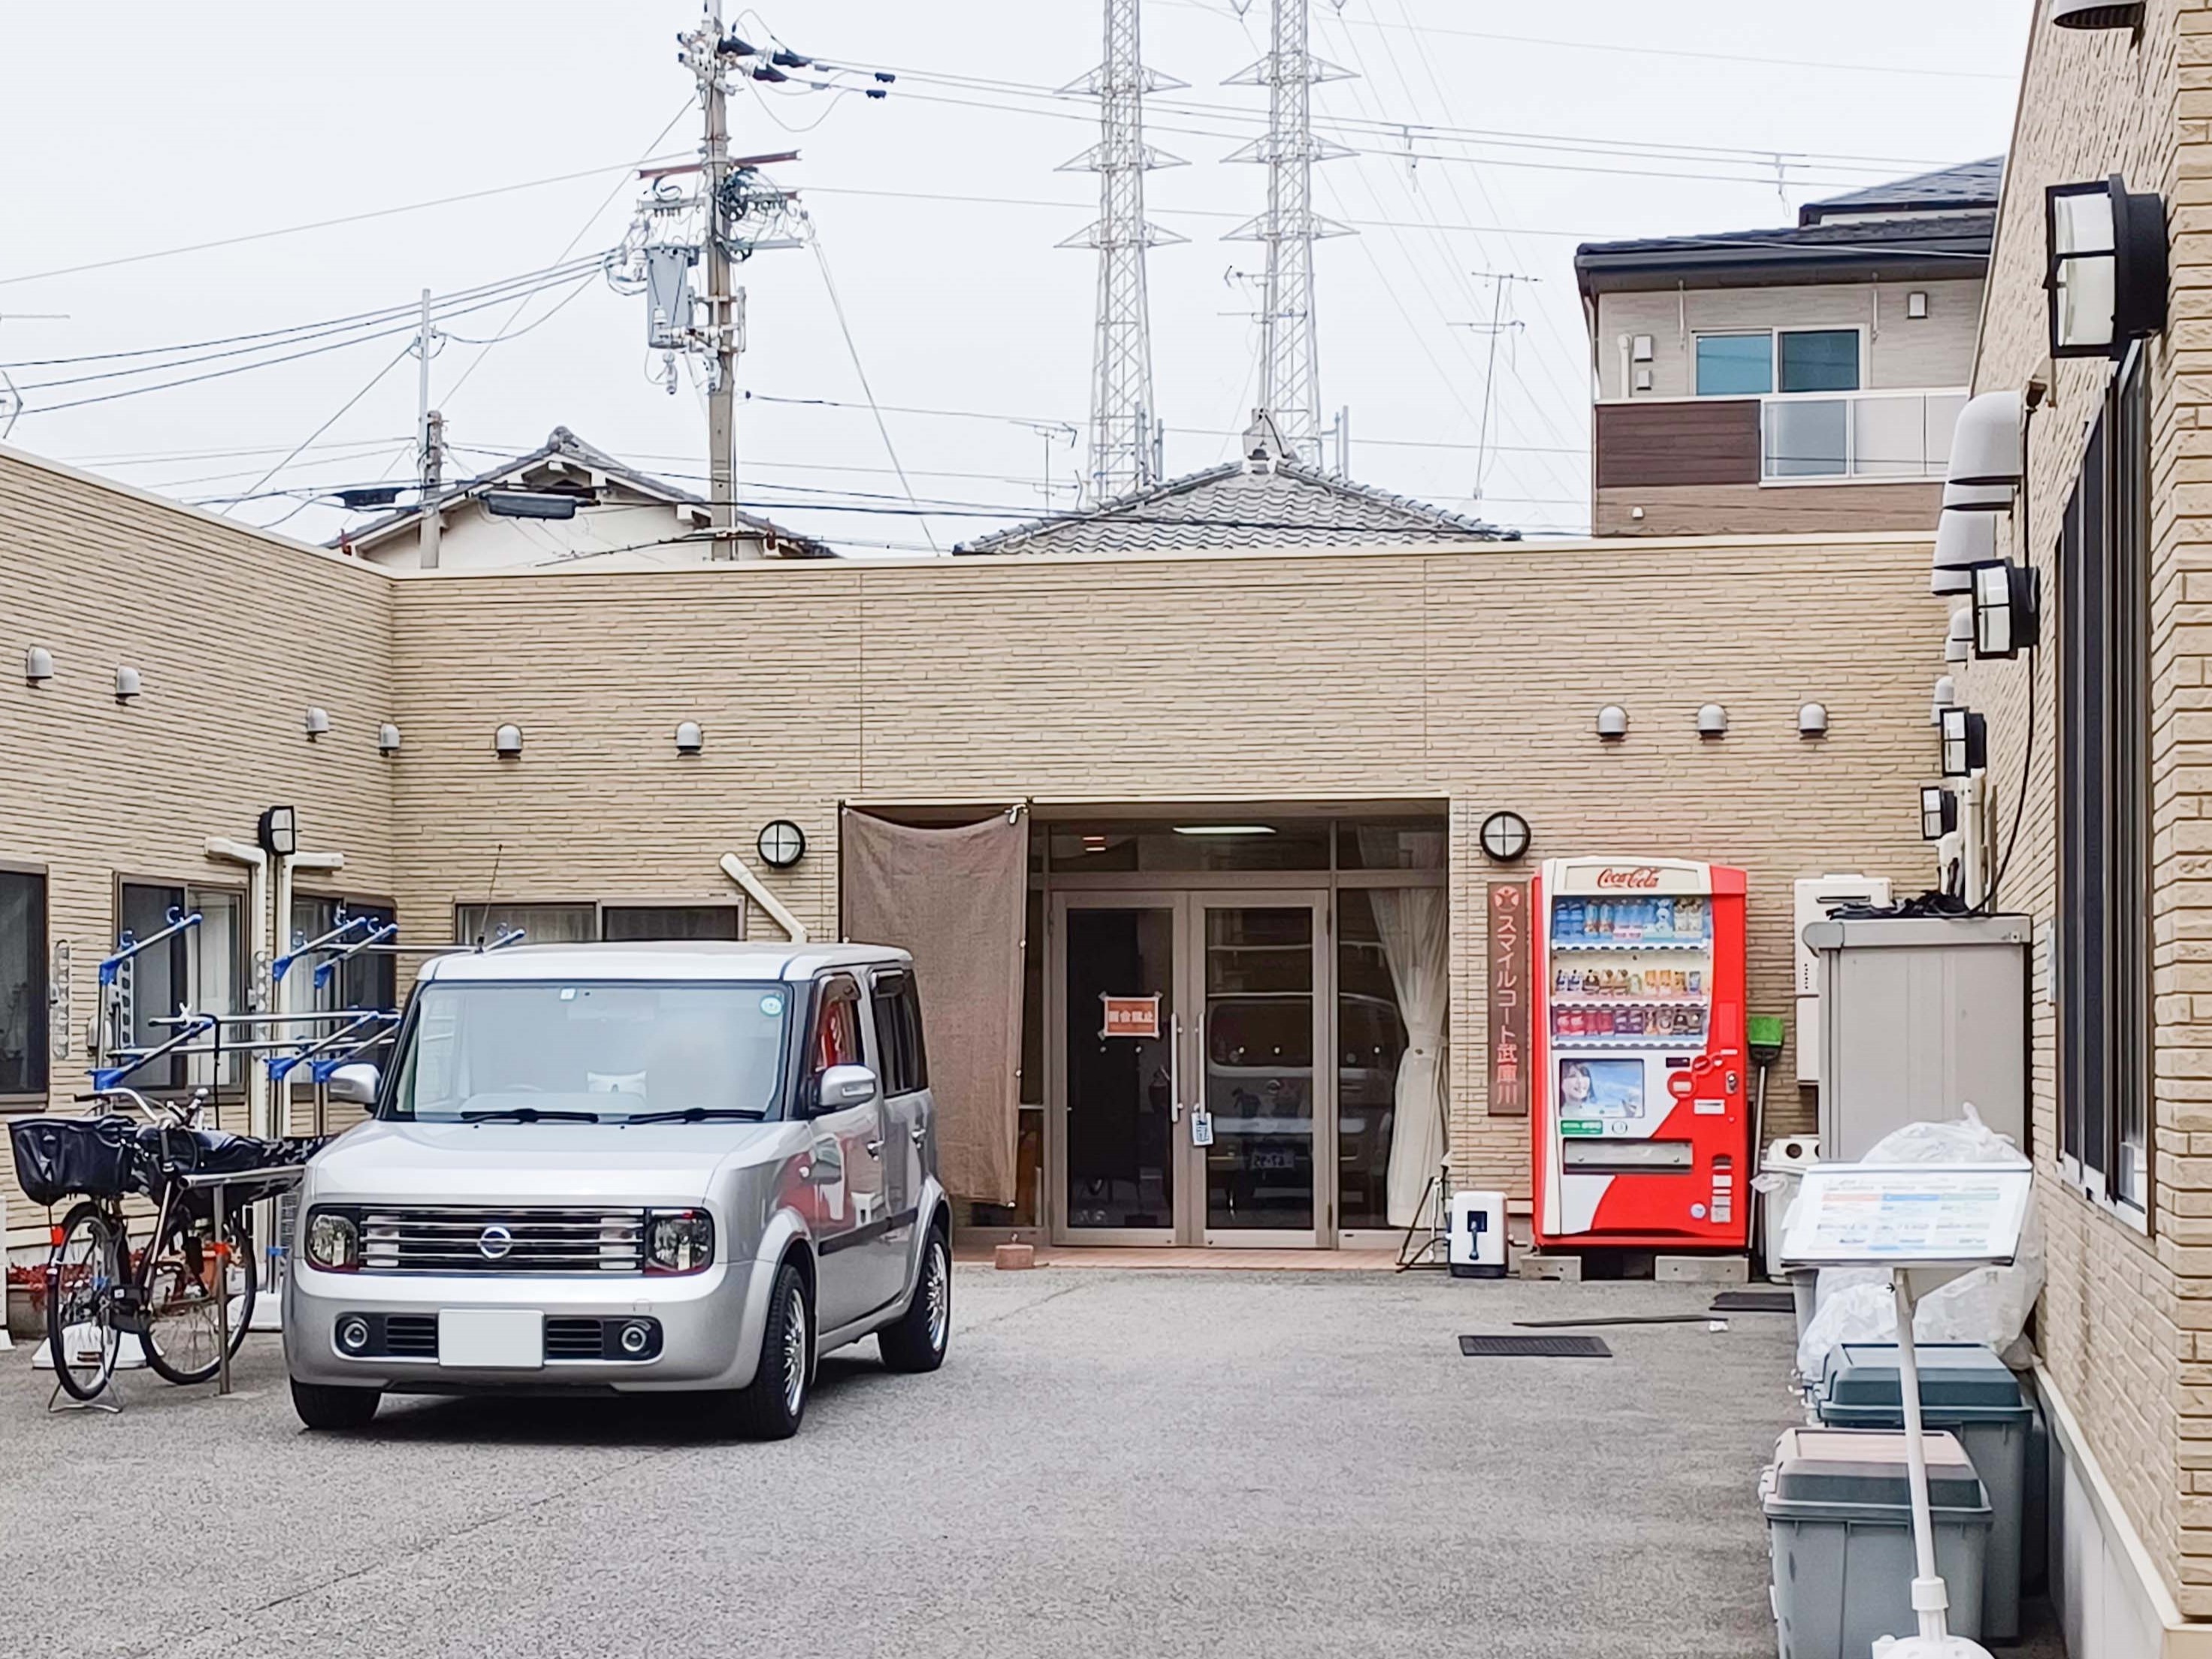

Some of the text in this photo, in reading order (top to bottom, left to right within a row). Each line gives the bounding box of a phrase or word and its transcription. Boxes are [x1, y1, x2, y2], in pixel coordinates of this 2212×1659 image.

[1497, 915, 1518, 1105] スマイルコート武庫川
